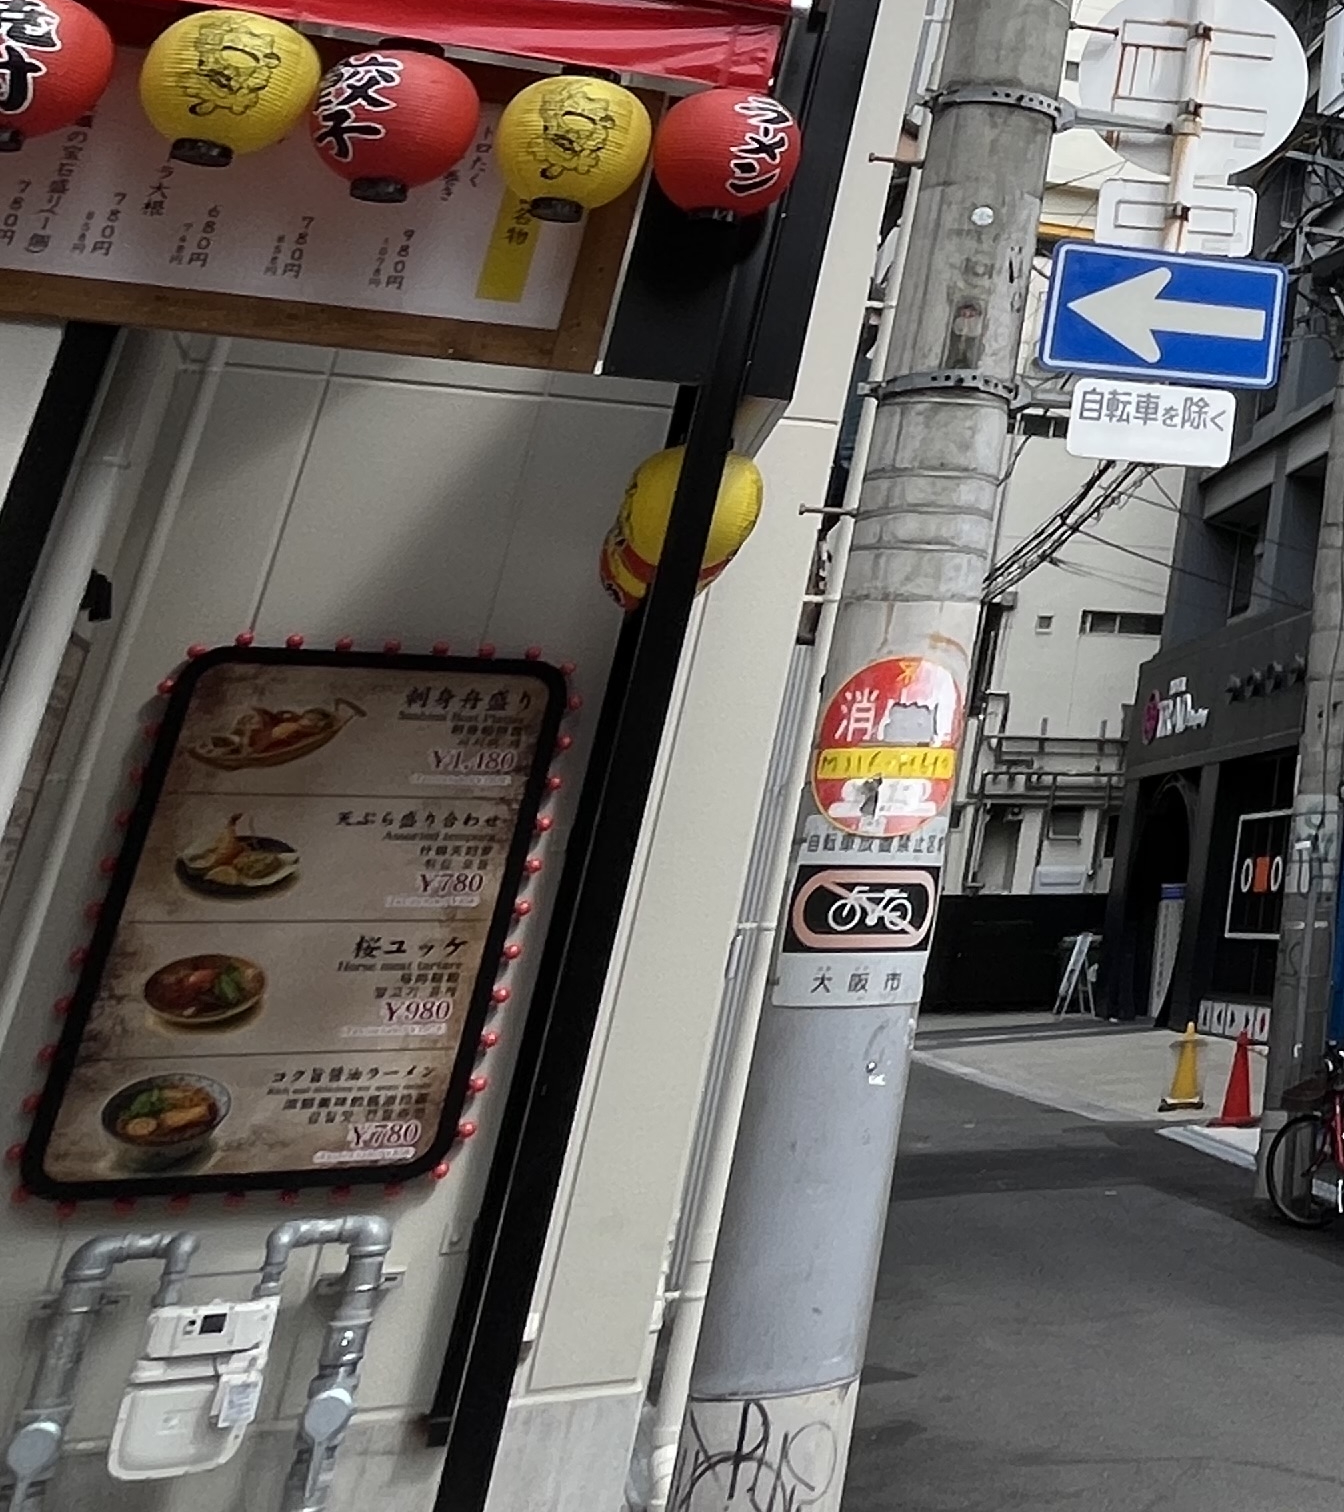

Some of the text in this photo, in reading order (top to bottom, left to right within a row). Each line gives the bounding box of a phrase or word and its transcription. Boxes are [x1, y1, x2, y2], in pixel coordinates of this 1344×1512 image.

[312, 52, 405, 163] 餃子
[726, 95, 794, 198] ラーメン
[1078, 387, 1226, 431] 自転車を除く
[354, 935, 468, 959] 桜ユッケ
[810, 972, 903, 994] 大阪市
